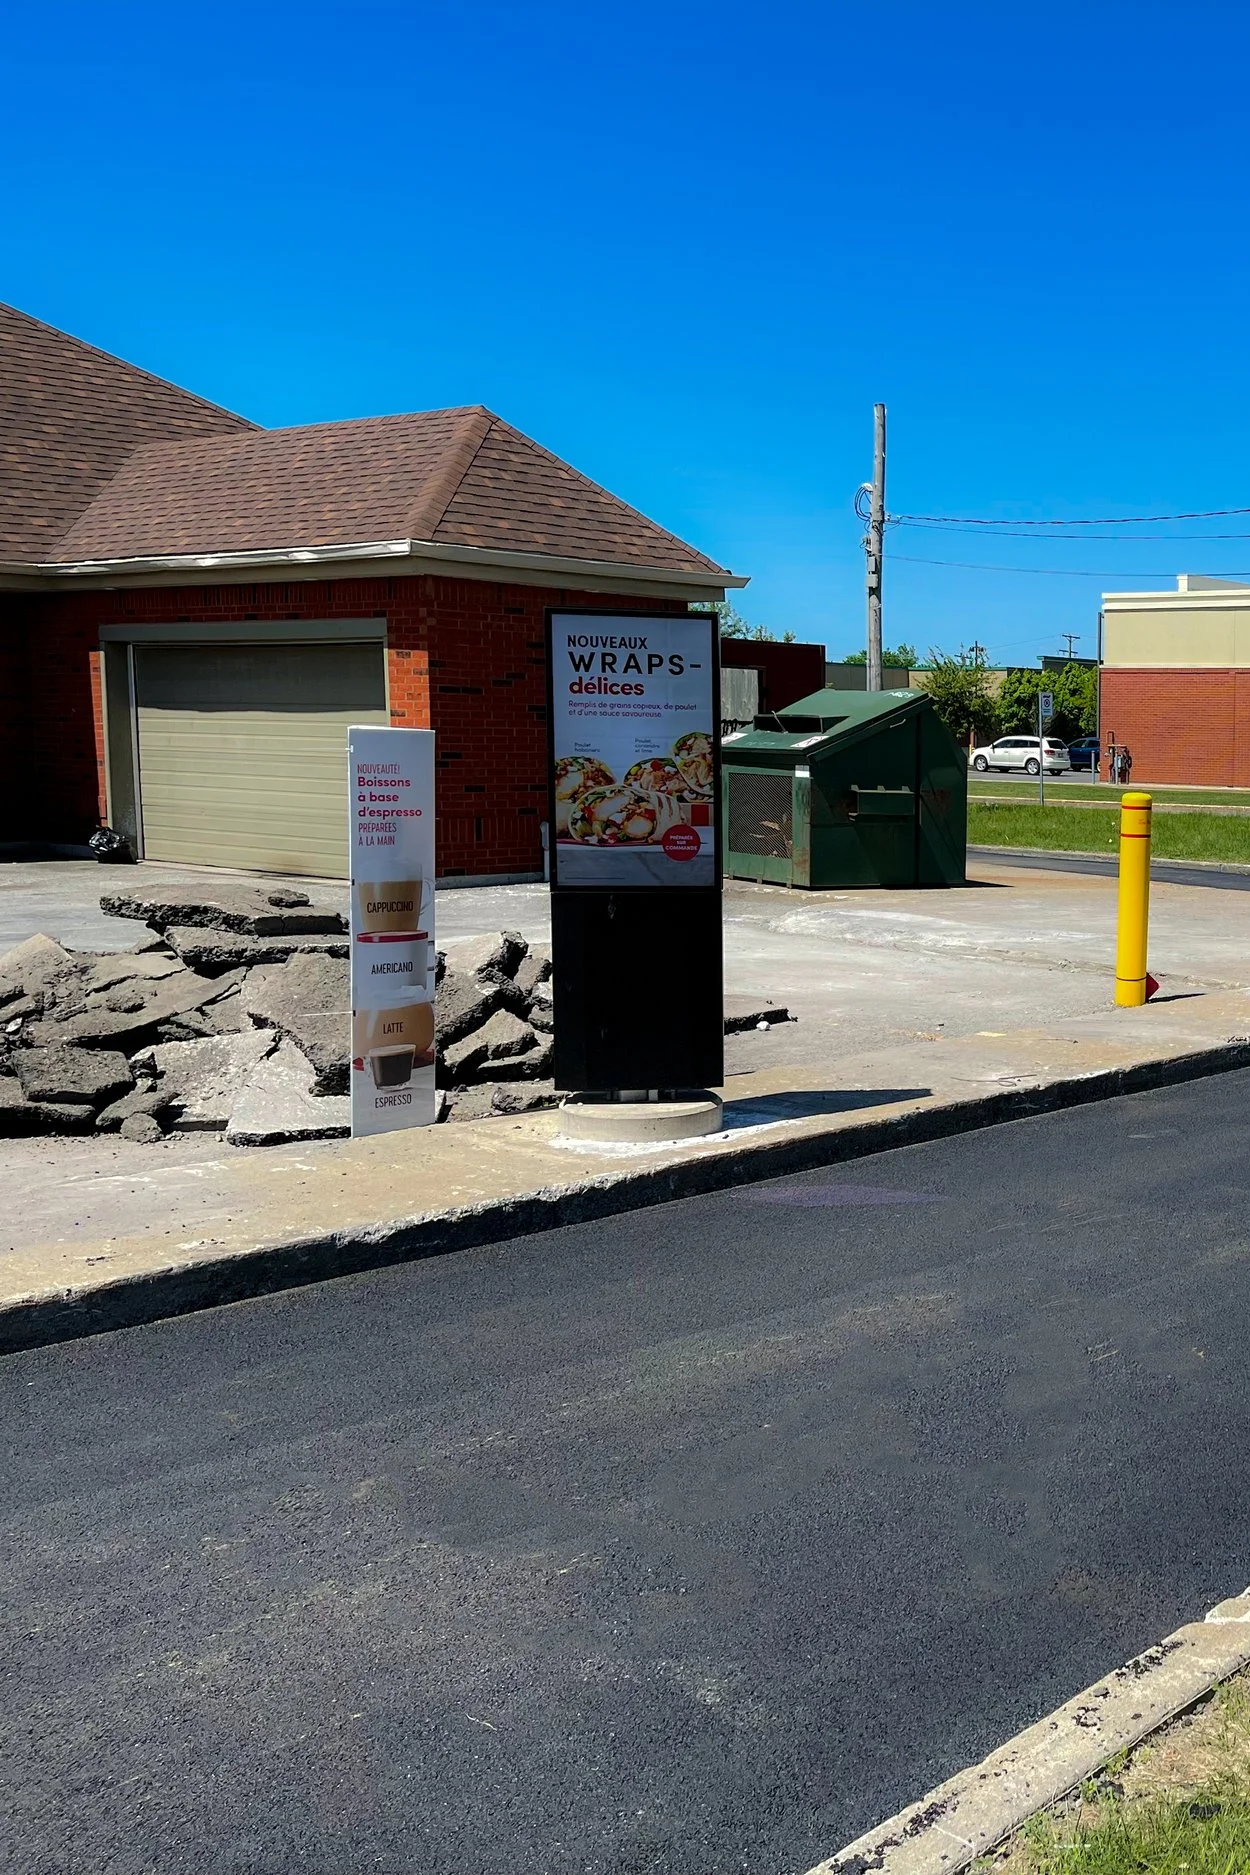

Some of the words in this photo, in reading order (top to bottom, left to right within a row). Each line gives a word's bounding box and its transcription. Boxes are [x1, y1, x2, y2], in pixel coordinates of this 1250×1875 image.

[567, 635, 648, 650] NOUVEAUX
[569, 676, 645, 696] délices
[568, 700, 597, 709] Remplis
[609, 702, 632, 710] grains
[663, 702, 674, 710] de
[675, 703, 697, 711] poulet
[357, 762, 401, 775] NOUVEAUTÉ!
[357, 776, 411, 787] Boissons
[358, 791, 366, 802] à
[369, 791, 400, 802] base
[358, 806, 422, 820] d'espresso
[366, 836, 375, 846] LA
[377, 835, 396, 846] MAIN
[366, 900, 414, 913] CAPPUCCINO
[371, 961, 413, 975] AMERICANO
[383, 1022, 404, 1035] LATTE
[375, 1093, 412, 1109] ESPRESSO
